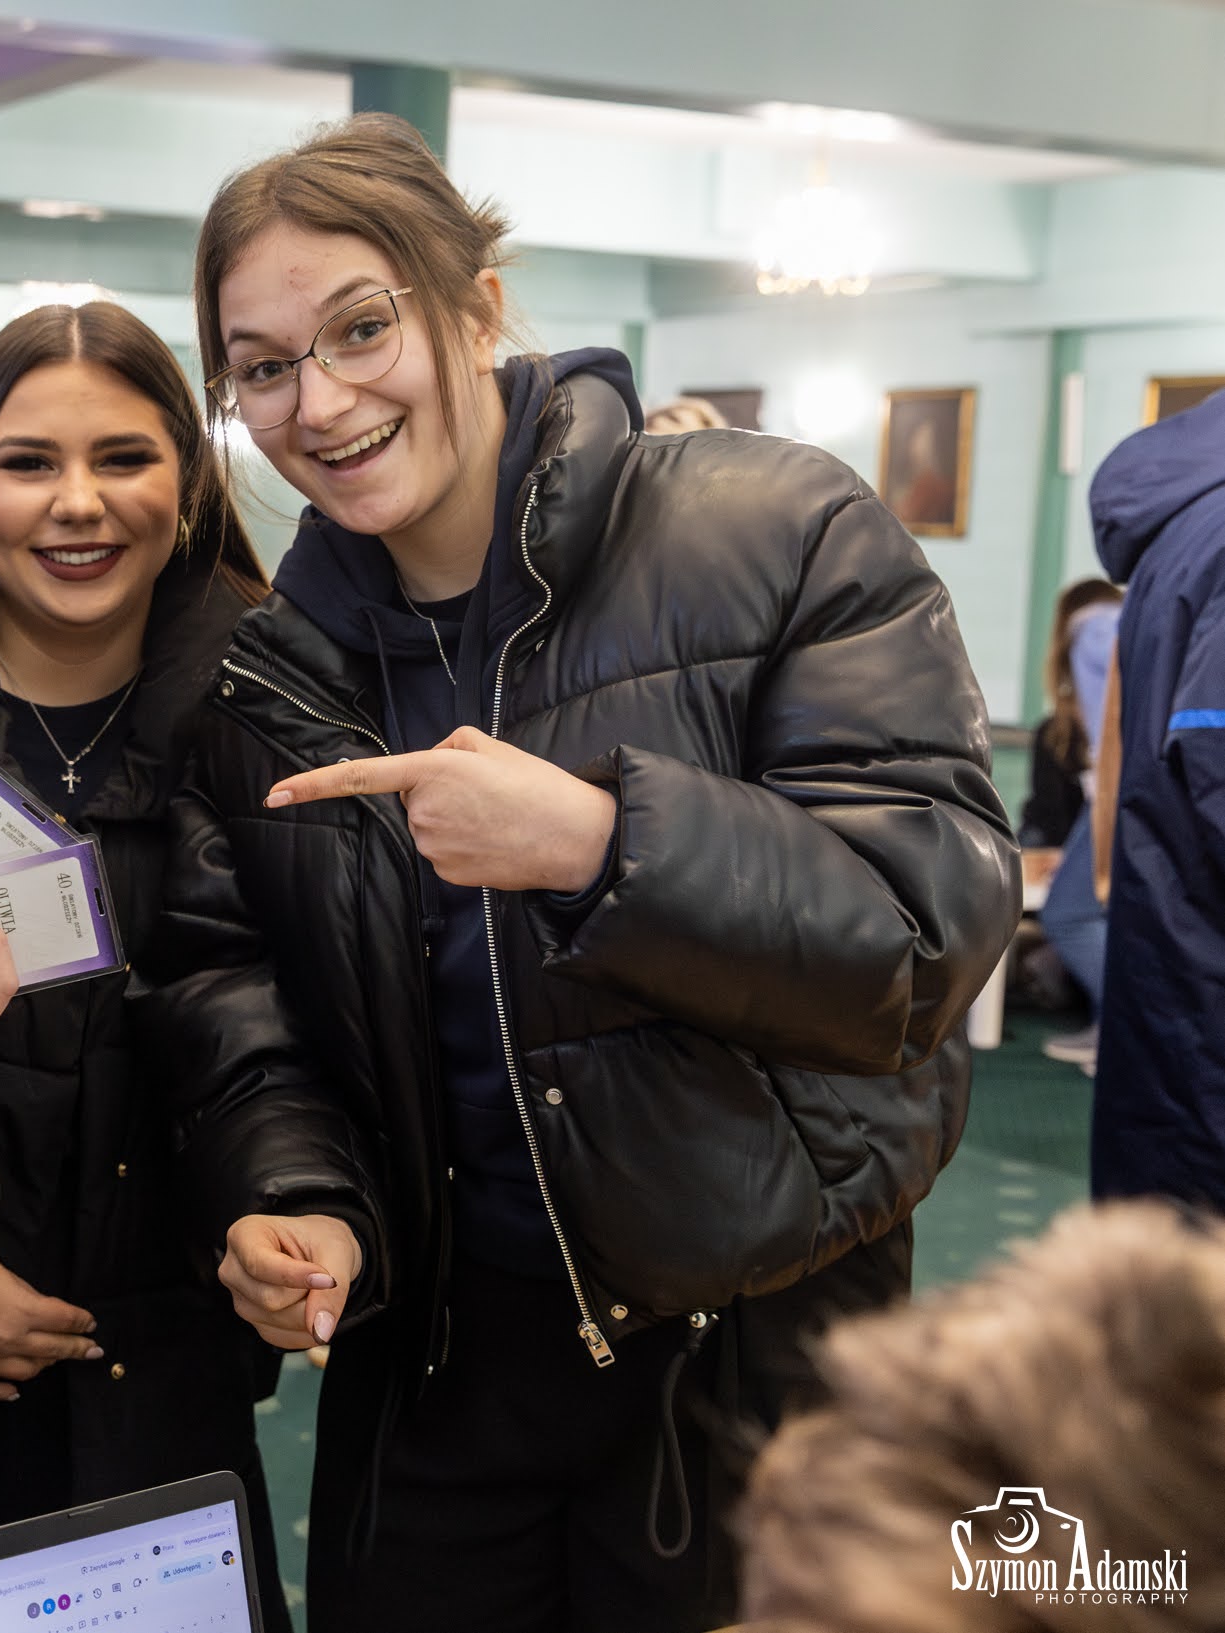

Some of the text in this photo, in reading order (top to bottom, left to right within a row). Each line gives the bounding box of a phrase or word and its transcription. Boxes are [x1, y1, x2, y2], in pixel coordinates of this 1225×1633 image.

[56, 872, 73, 895] 40.
[108, 1557, 125, 1566] Google
[172, 1561, 202, 1576] Udostępnij
